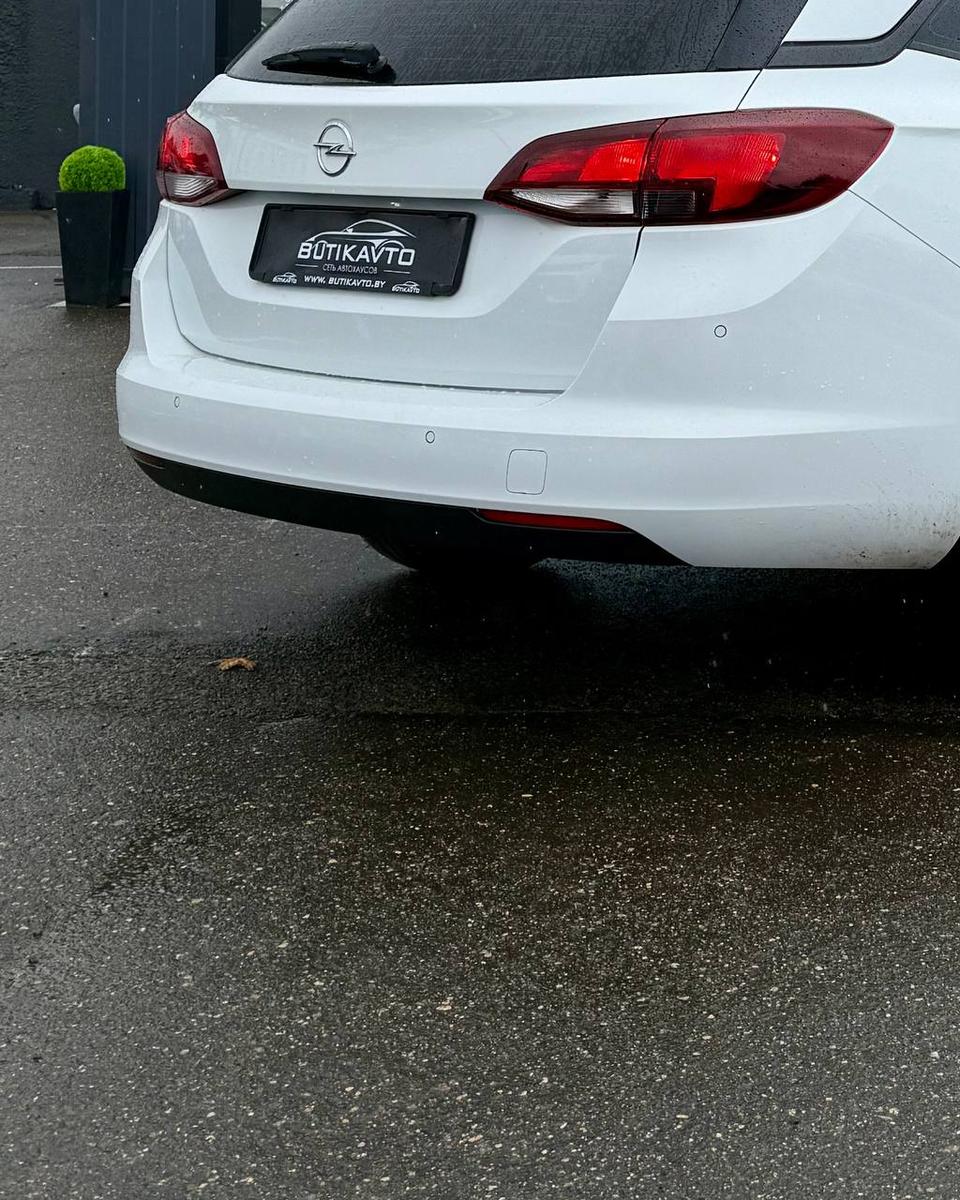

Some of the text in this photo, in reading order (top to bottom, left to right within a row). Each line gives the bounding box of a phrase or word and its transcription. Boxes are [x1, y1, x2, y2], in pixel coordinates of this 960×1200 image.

[297, 242, 416, 266] BUTIKAVTO
[322, 263, 378, 274] СЕТЬ АВТОХАУСОВ
[328, 278, 386, 288] BUTIKAVTO.BY
